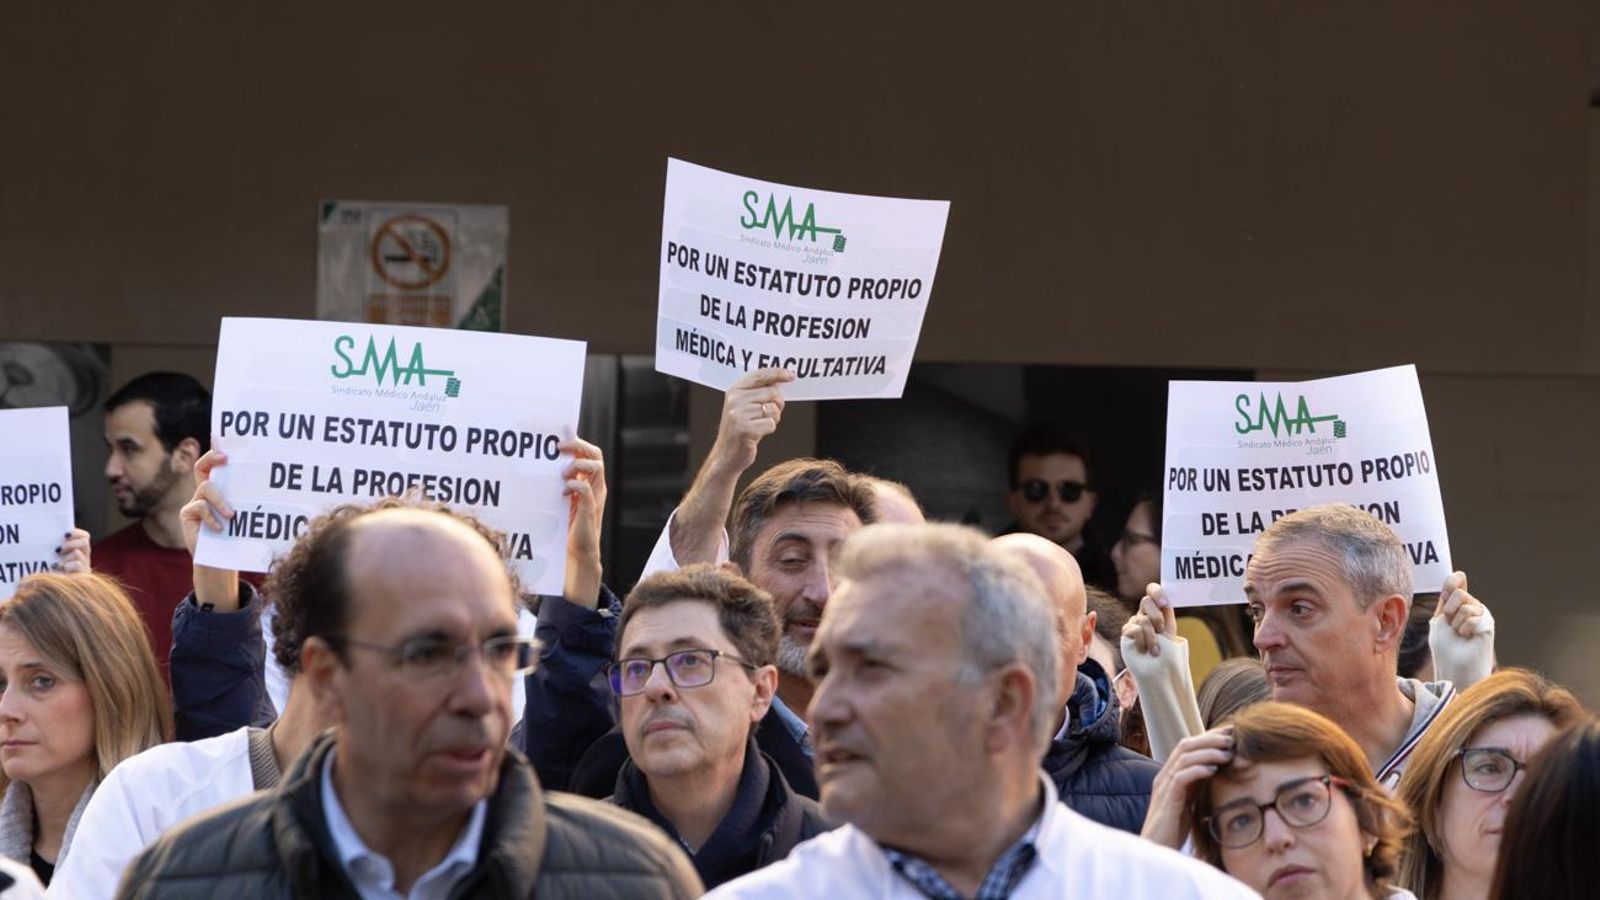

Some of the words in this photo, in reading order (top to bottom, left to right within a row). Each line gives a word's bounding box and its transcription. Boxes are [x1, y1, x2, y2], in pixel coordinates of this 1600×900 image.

[741, 190, 817, 242] SMA
[667, 241, 700, 272] POR
[705, 252, 729, 280] UN
[734, 261, 842, 298] ESTATUTO
[847, 277, 922, 300] PROPIO
[700, 294, 721, 321] DE
[726, 302, 747, 329] LA
[752, 309, 871, 339] PROFESION
[331, 334, 426, 388] SMA
[675, 328, 737, 369] MÉDICA
[742, 349, 753, 373] Y
[220, 410, 270, 438] POR
[279, 413, 316, 440] UN
[323, 416, 457, 452] ESTATUTO
[466, 429, 561, 461] PROPIO
[1235, 391, 1316, 438] SMA
[270, 462, 304, 491] DE
[311, 465, 344, 495] LA
[1169, 467, 1198, 492] POR
[1203, 468, 1231, 492] UN
[1238, 462, 1354, 492] ESTATUTO
[1361, 450, 1430, 484] PROPIO
[229, 505, 310, 541] MÉDIC
[1201, 512, 1230, 536] DE
[1236, 511, 1265, 534] LA
[1175, 550, 1253, 580] MÉDIC
